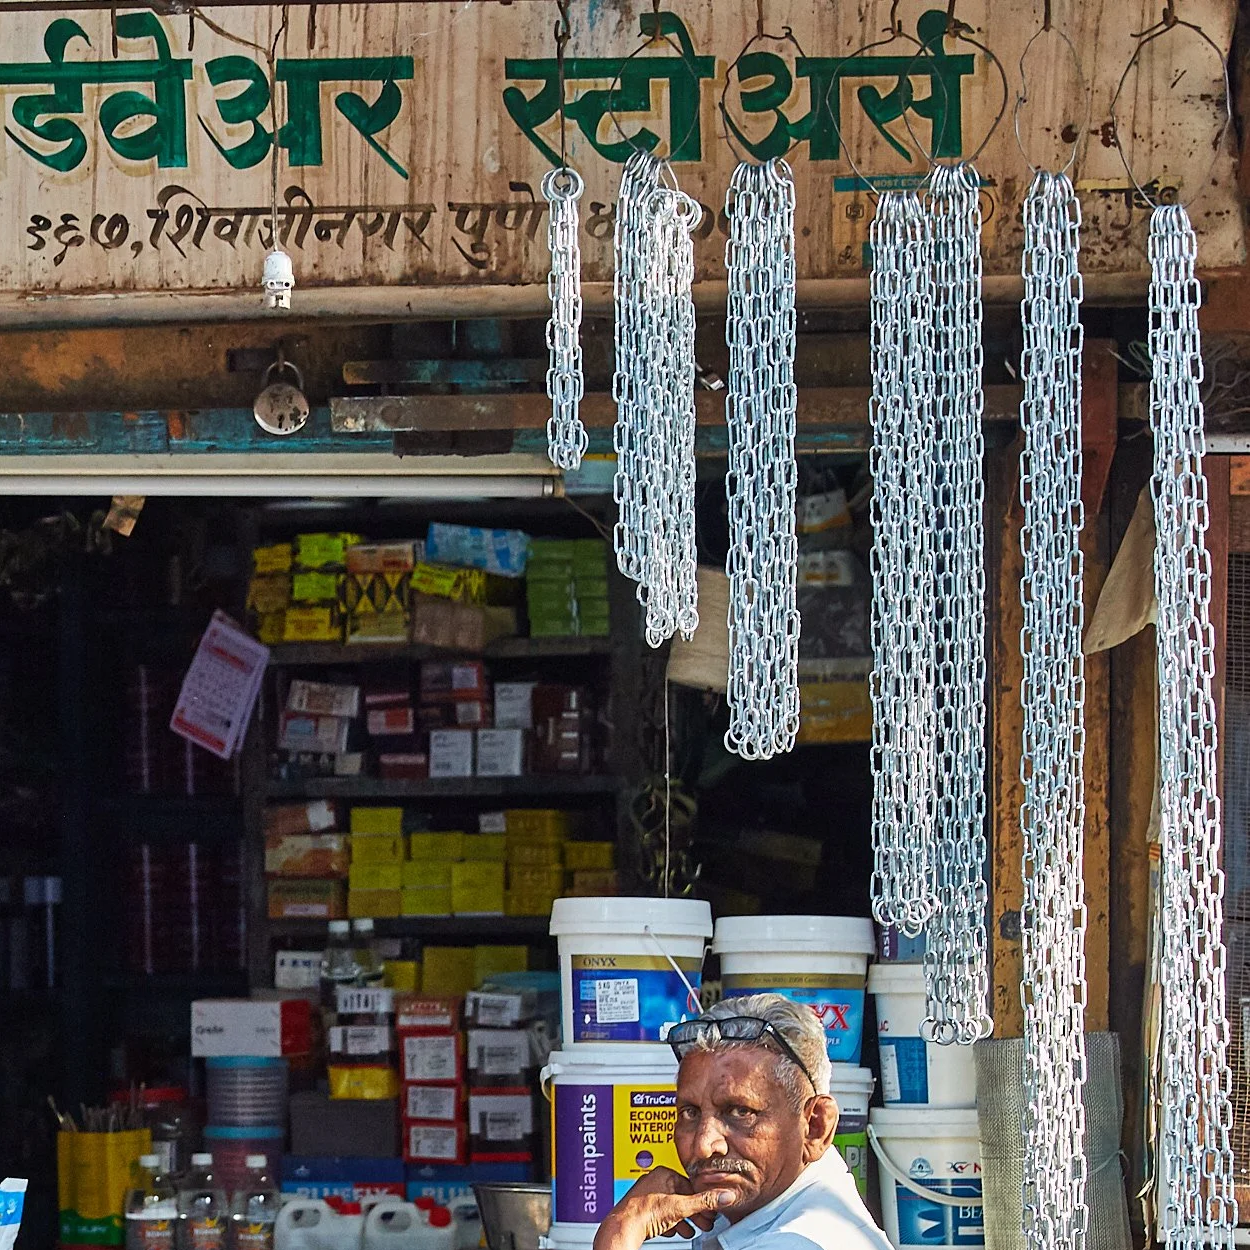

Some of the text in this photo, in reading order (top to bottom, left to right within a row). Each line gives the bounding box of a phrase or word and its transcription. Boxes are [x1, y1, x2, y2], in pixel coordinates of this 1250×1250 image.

[503, 9, 975, 166] स्टोअर्स
[583, 957, 617, 967] ONYX
[630, 1110, 677, 1121] ECONOM
[630, 1122, 674, 1132] INTERIO
[630, 1133, 664, 1144] WALL
[580, 1093, 605, 1214] asianpaints
